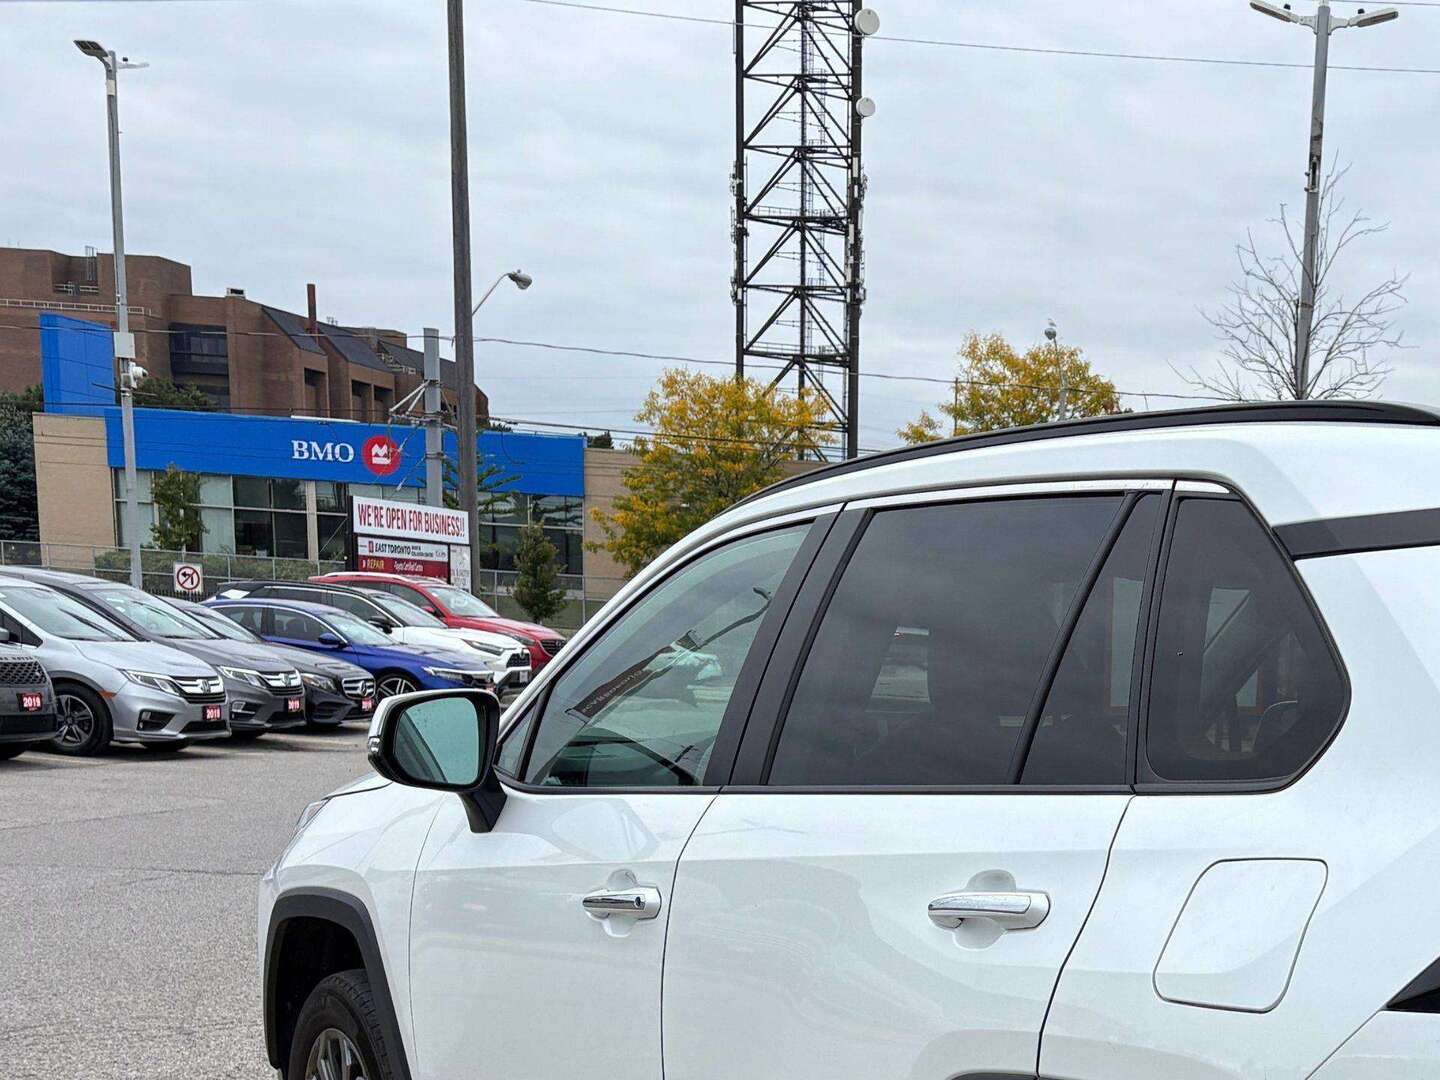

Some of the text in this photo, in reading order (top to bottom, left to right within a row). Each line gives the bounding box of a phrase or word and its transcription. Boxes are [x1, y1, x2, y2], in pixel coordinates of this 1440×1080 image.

[291, 439, 355, 463] BMO
[358, 504, 465, 537] WE'RE OPEN FOR BUSINESS!!
[375, 541, 387, 554] EAST
[388, 544, 411, 555] TORONTO
[22, 696, 41, 708] 2019
